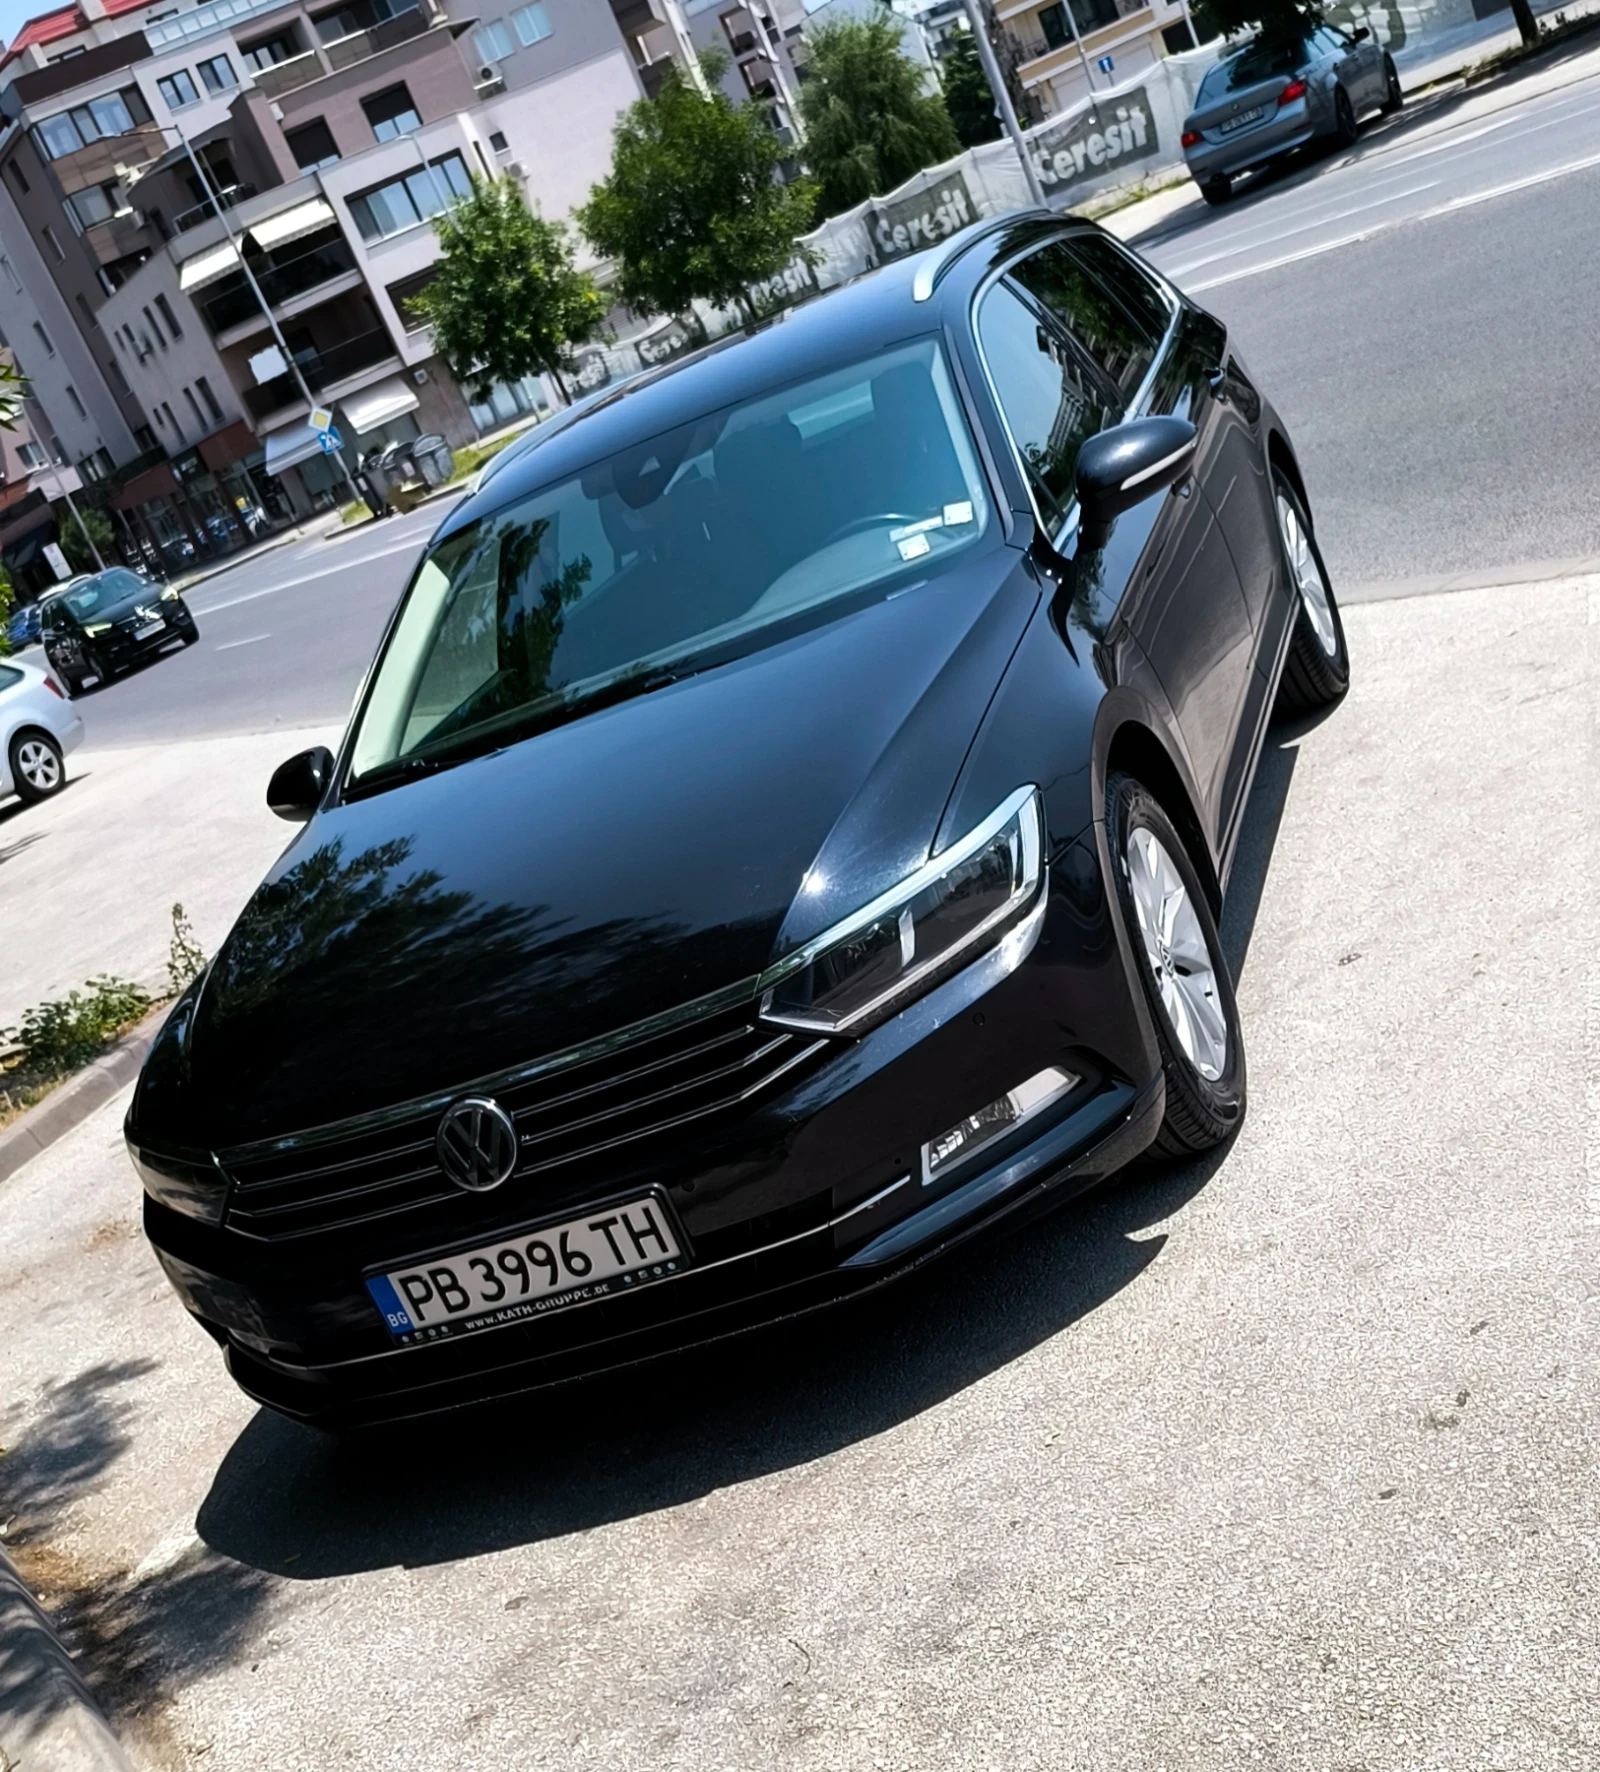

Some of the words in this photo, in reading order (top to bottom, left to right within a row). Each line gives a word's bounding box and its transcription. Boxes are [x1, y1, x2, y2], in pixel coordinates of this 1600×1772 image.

[1033, 106, 1147, 185] Ceresit
[876, 189, 970, 253] Ceresit
[749, 256, 813, 316] eresit
[398, 1267, 471, 1322] PB
[469, 1230, 593, 1304] 3996
[588, 1207, 670, 1266] TH
[387, 1311, 409, 1328] BG
